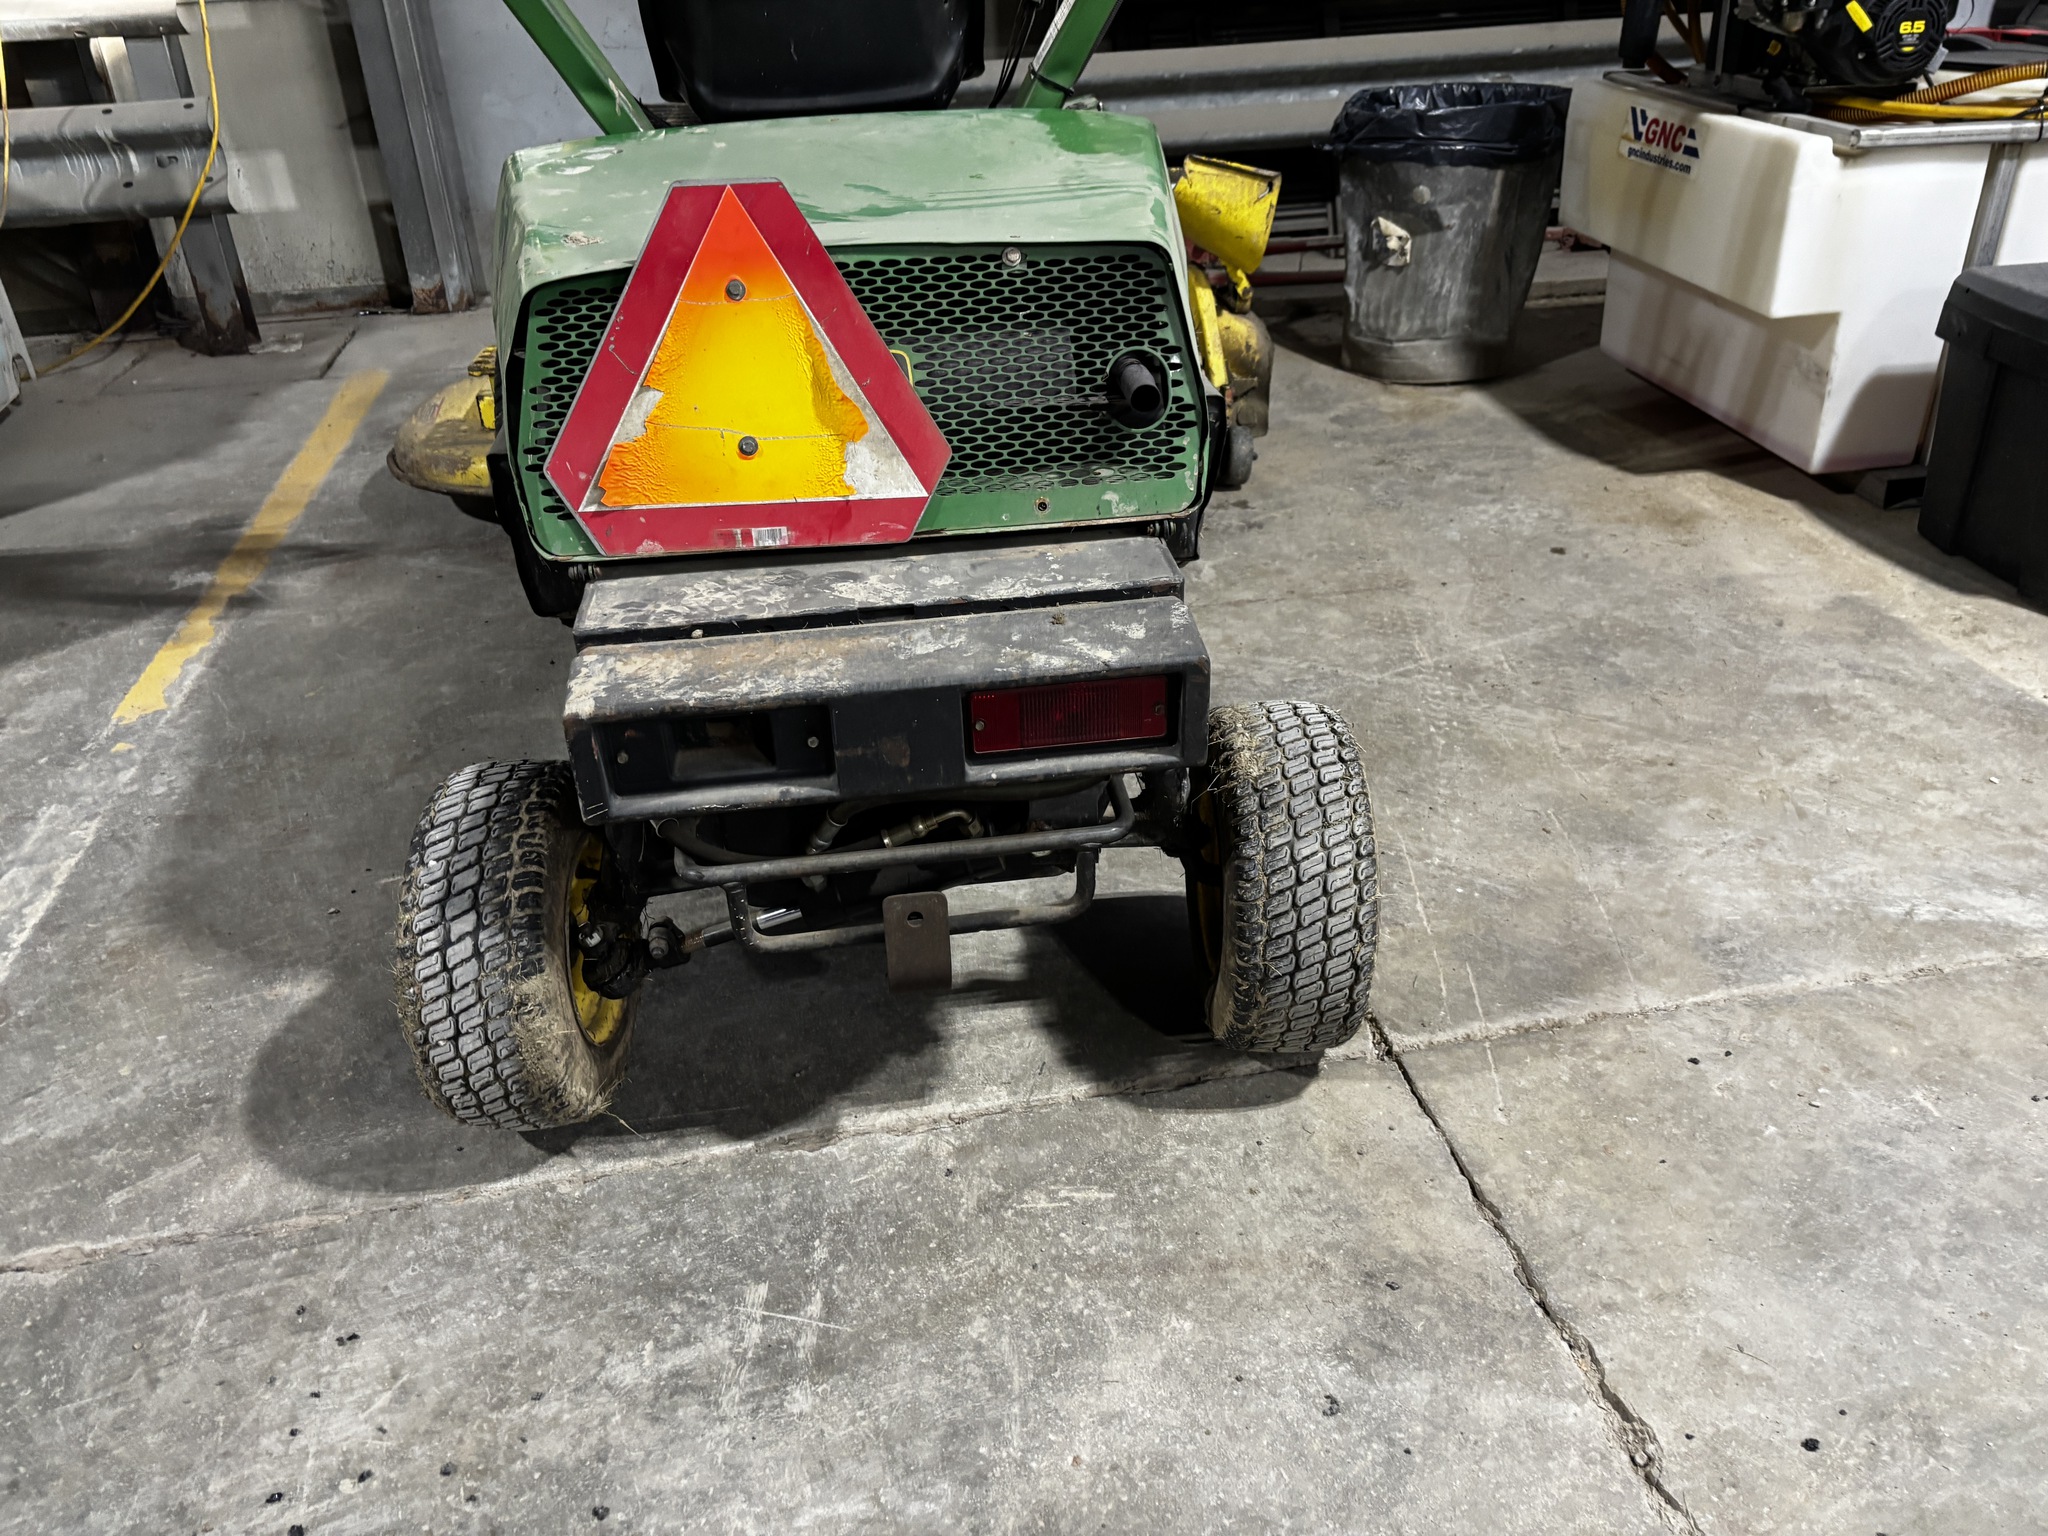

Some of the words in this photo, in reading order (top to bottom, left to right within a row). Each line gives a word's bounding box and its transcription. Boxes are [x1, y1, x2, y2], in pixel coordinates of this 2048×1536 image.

[1899, 20, 1926, 34] 6.5
[1645, 117, 1687, 153] GNC
[1627, 146, 1692, 175] gncindustries.com
